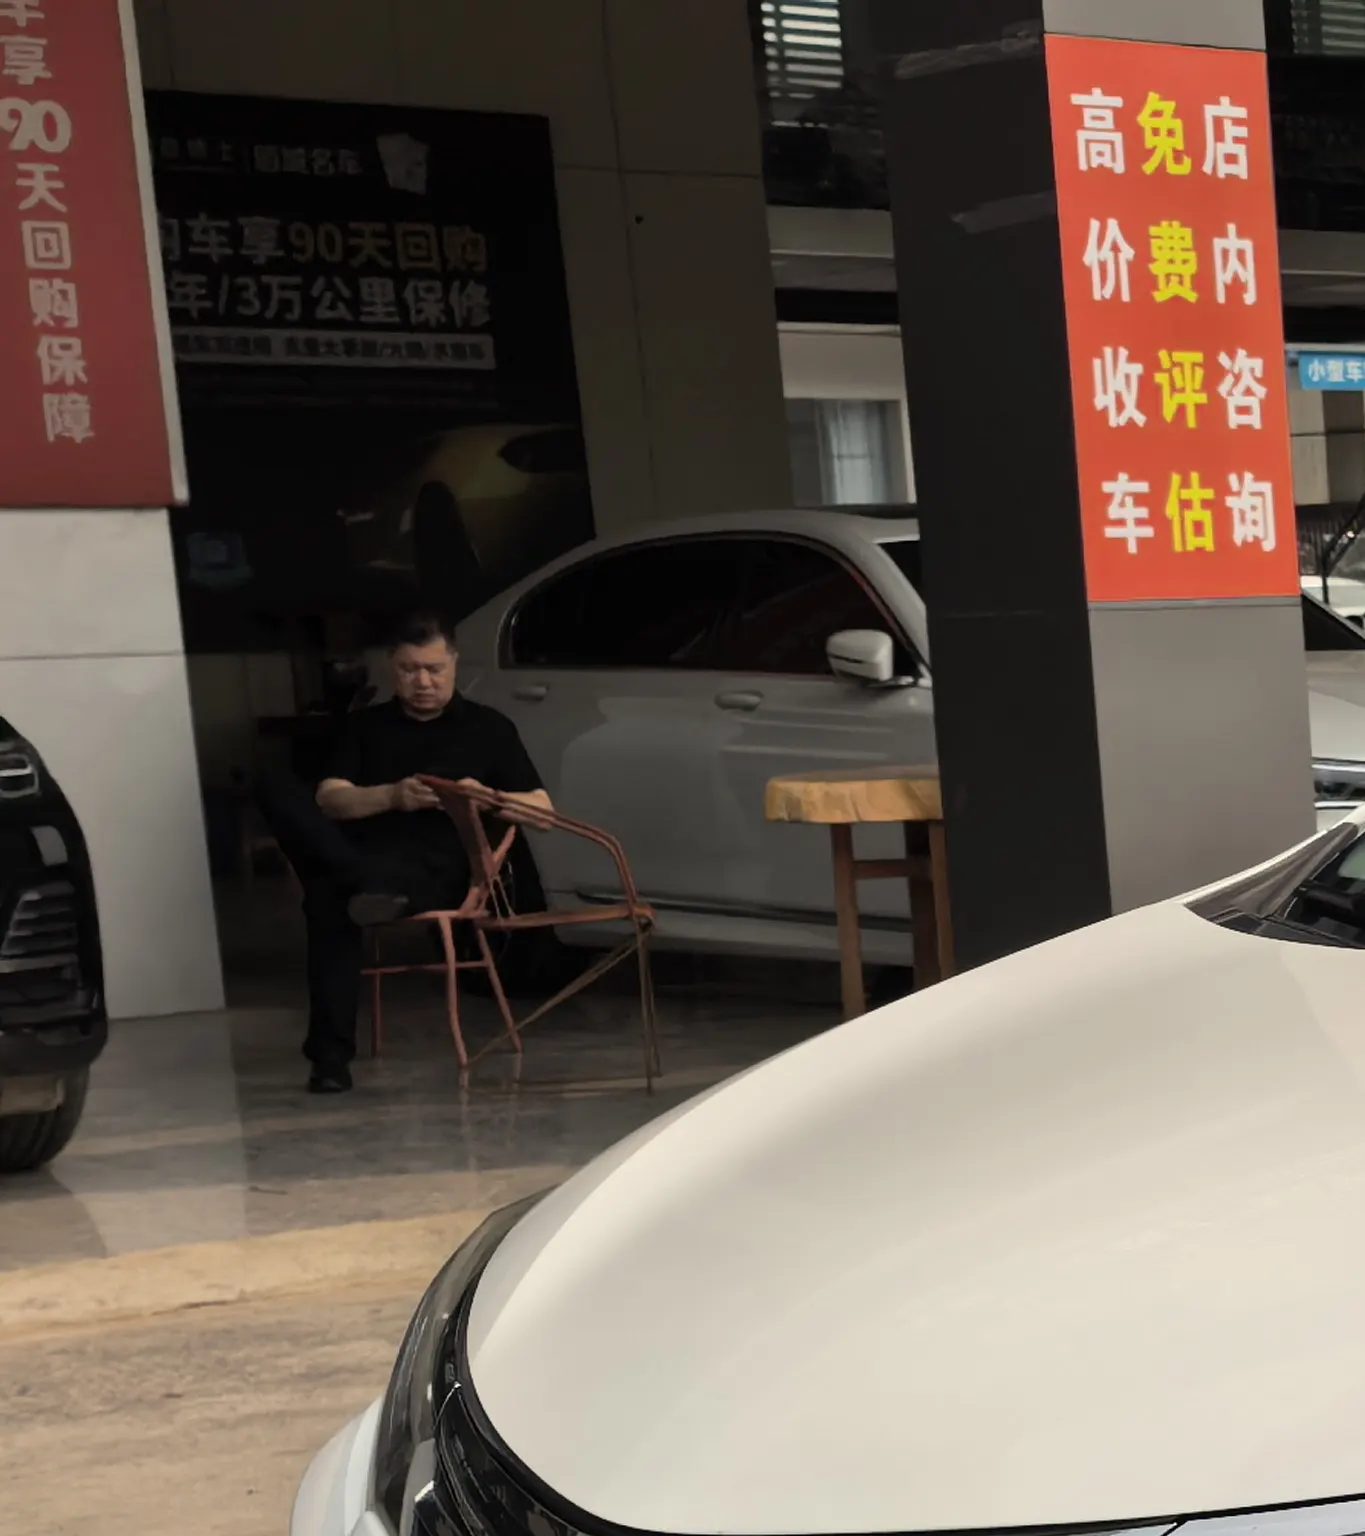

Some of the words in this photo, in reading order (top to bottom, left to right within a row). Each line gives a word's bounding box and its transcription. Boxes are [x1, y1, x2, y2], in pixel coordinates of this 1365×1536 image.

[1070, 87, 1154, 554] 高价收车
[1136, 91, 1216, 552] 免费评估
[1201, 96, 1277, 551] 店内咨询
